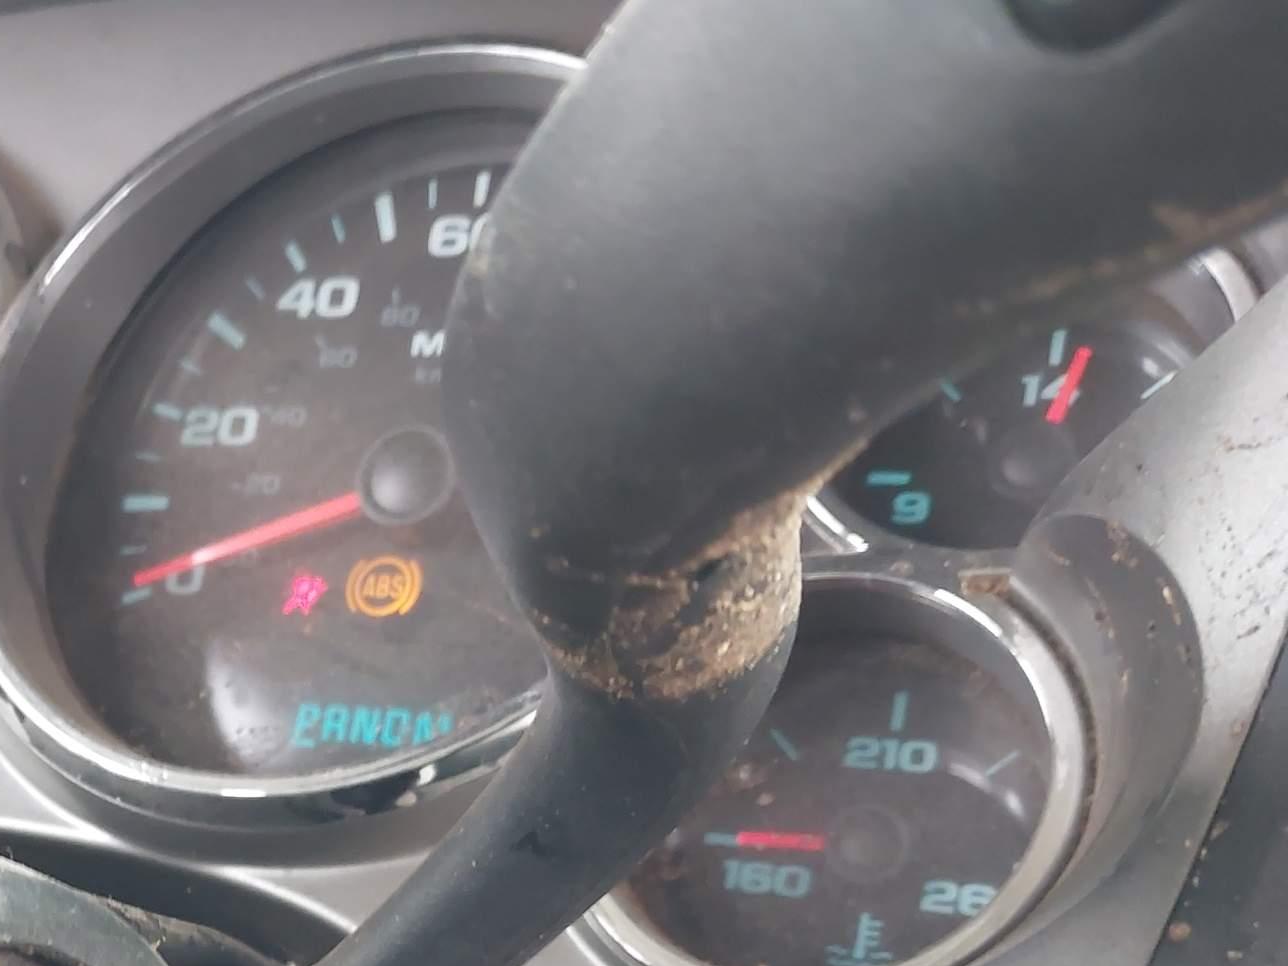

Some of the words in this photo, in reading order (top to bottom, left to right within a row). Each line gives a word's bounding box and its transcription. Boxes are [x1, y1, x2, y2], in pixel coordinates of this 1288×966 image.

[276, 276, 361, 319] 40
[180, 406, 260, 446] 20
[889, 491, 932, 525] 9
[362, 574, 407, 599] ABS
[841, 735, 939, 775] 210
[722, 858, 812, 899] 160
